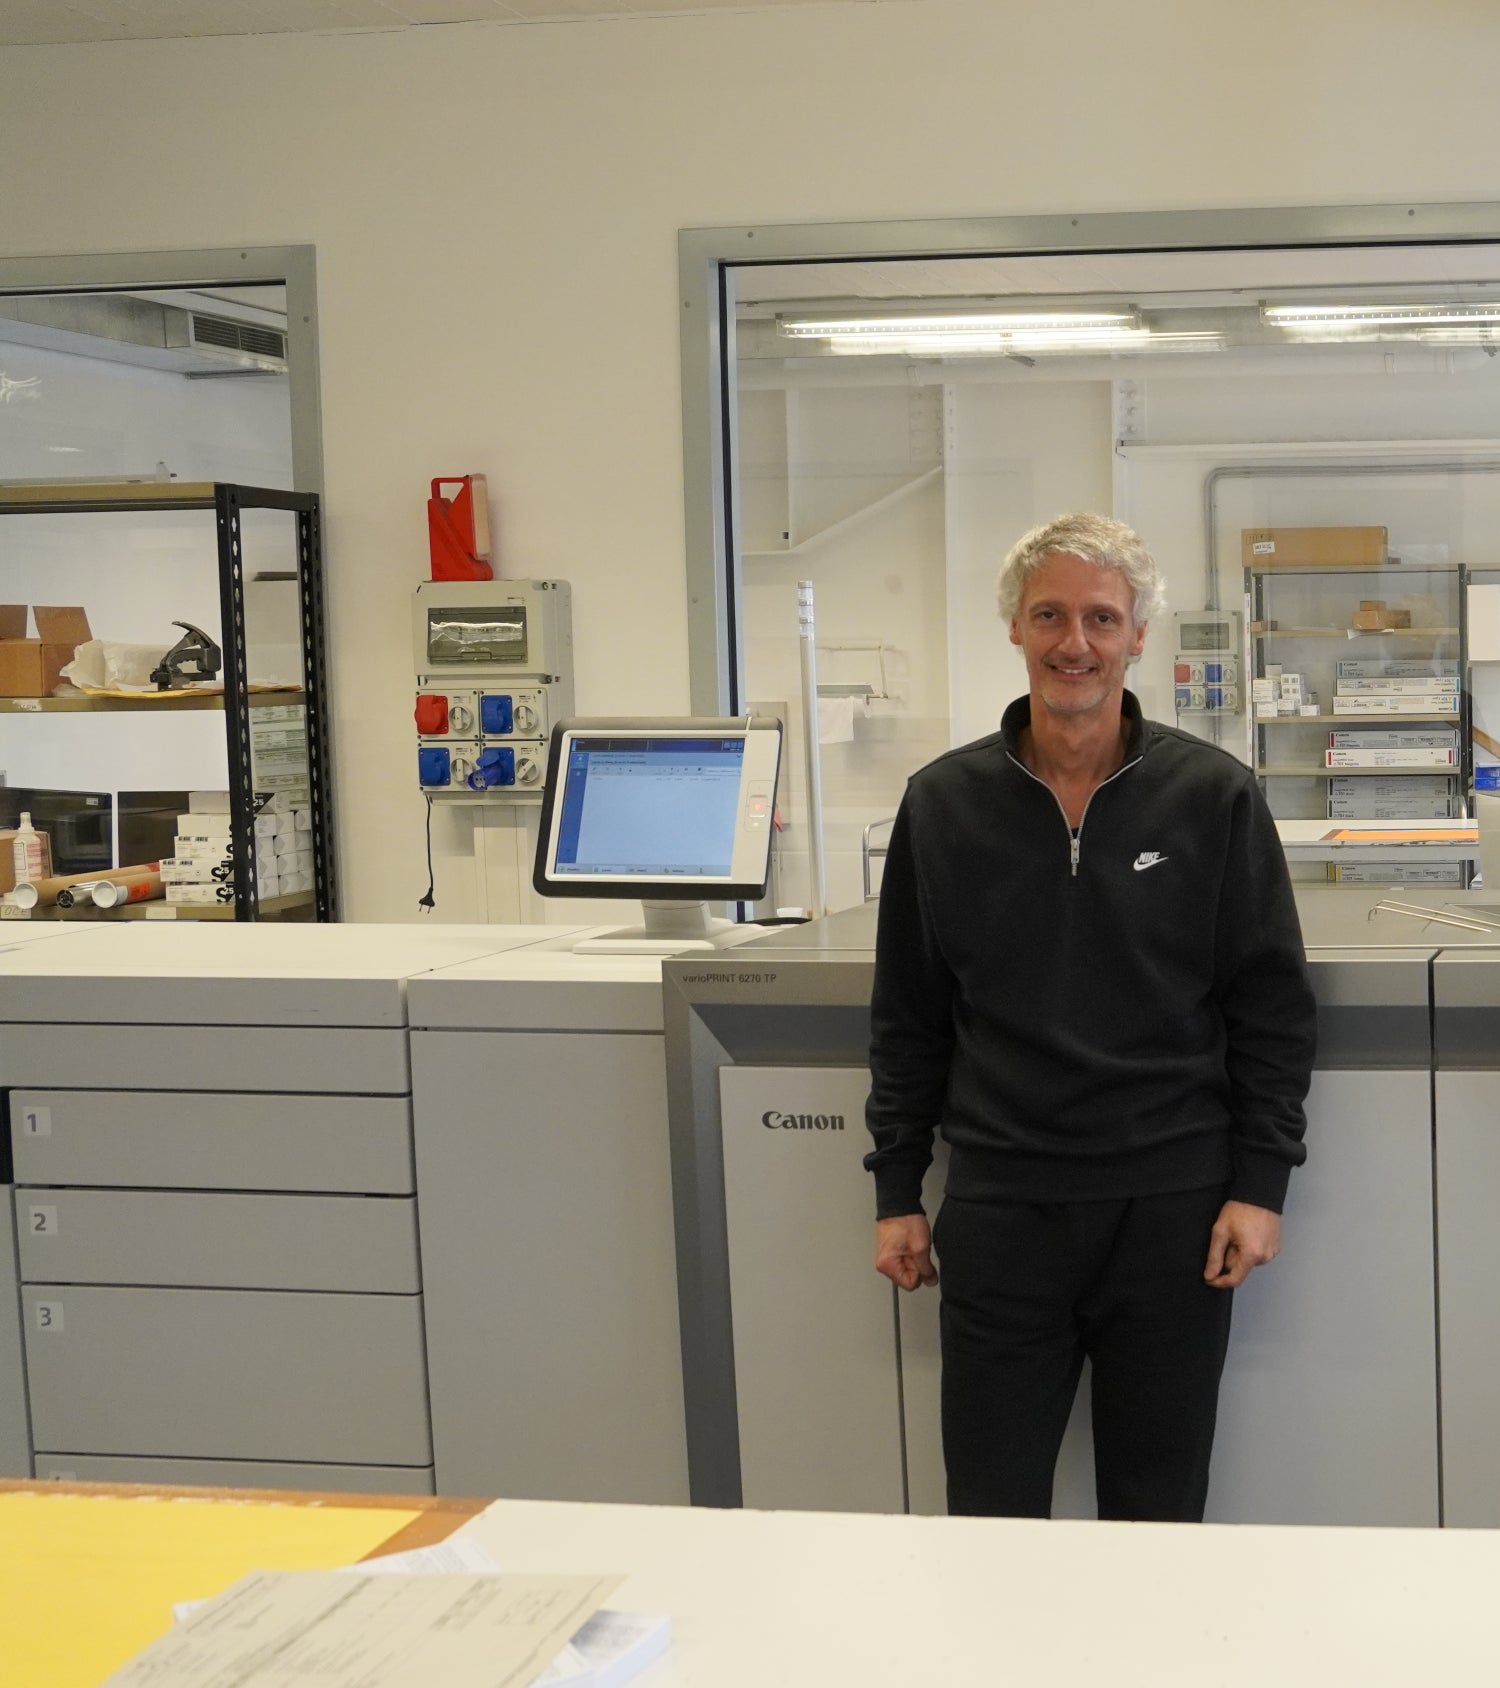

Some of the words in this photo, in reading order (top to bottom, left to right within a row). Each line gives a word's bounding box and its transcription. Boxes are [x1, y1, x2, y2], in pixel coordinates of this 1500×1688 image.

[1138, 852, 1160, 863] NIKE
[682, 973, 736, 983] varioPRINT
[738, 974, 761, 983] 6270
[764, 974, 777, 983] TP
[27, 1113, 37, 1132] 1
[761, 1110, 845, 1130] Canon
[33, 1212, 46, 1231] 2
[39, 1307, 52, 1326] 3
